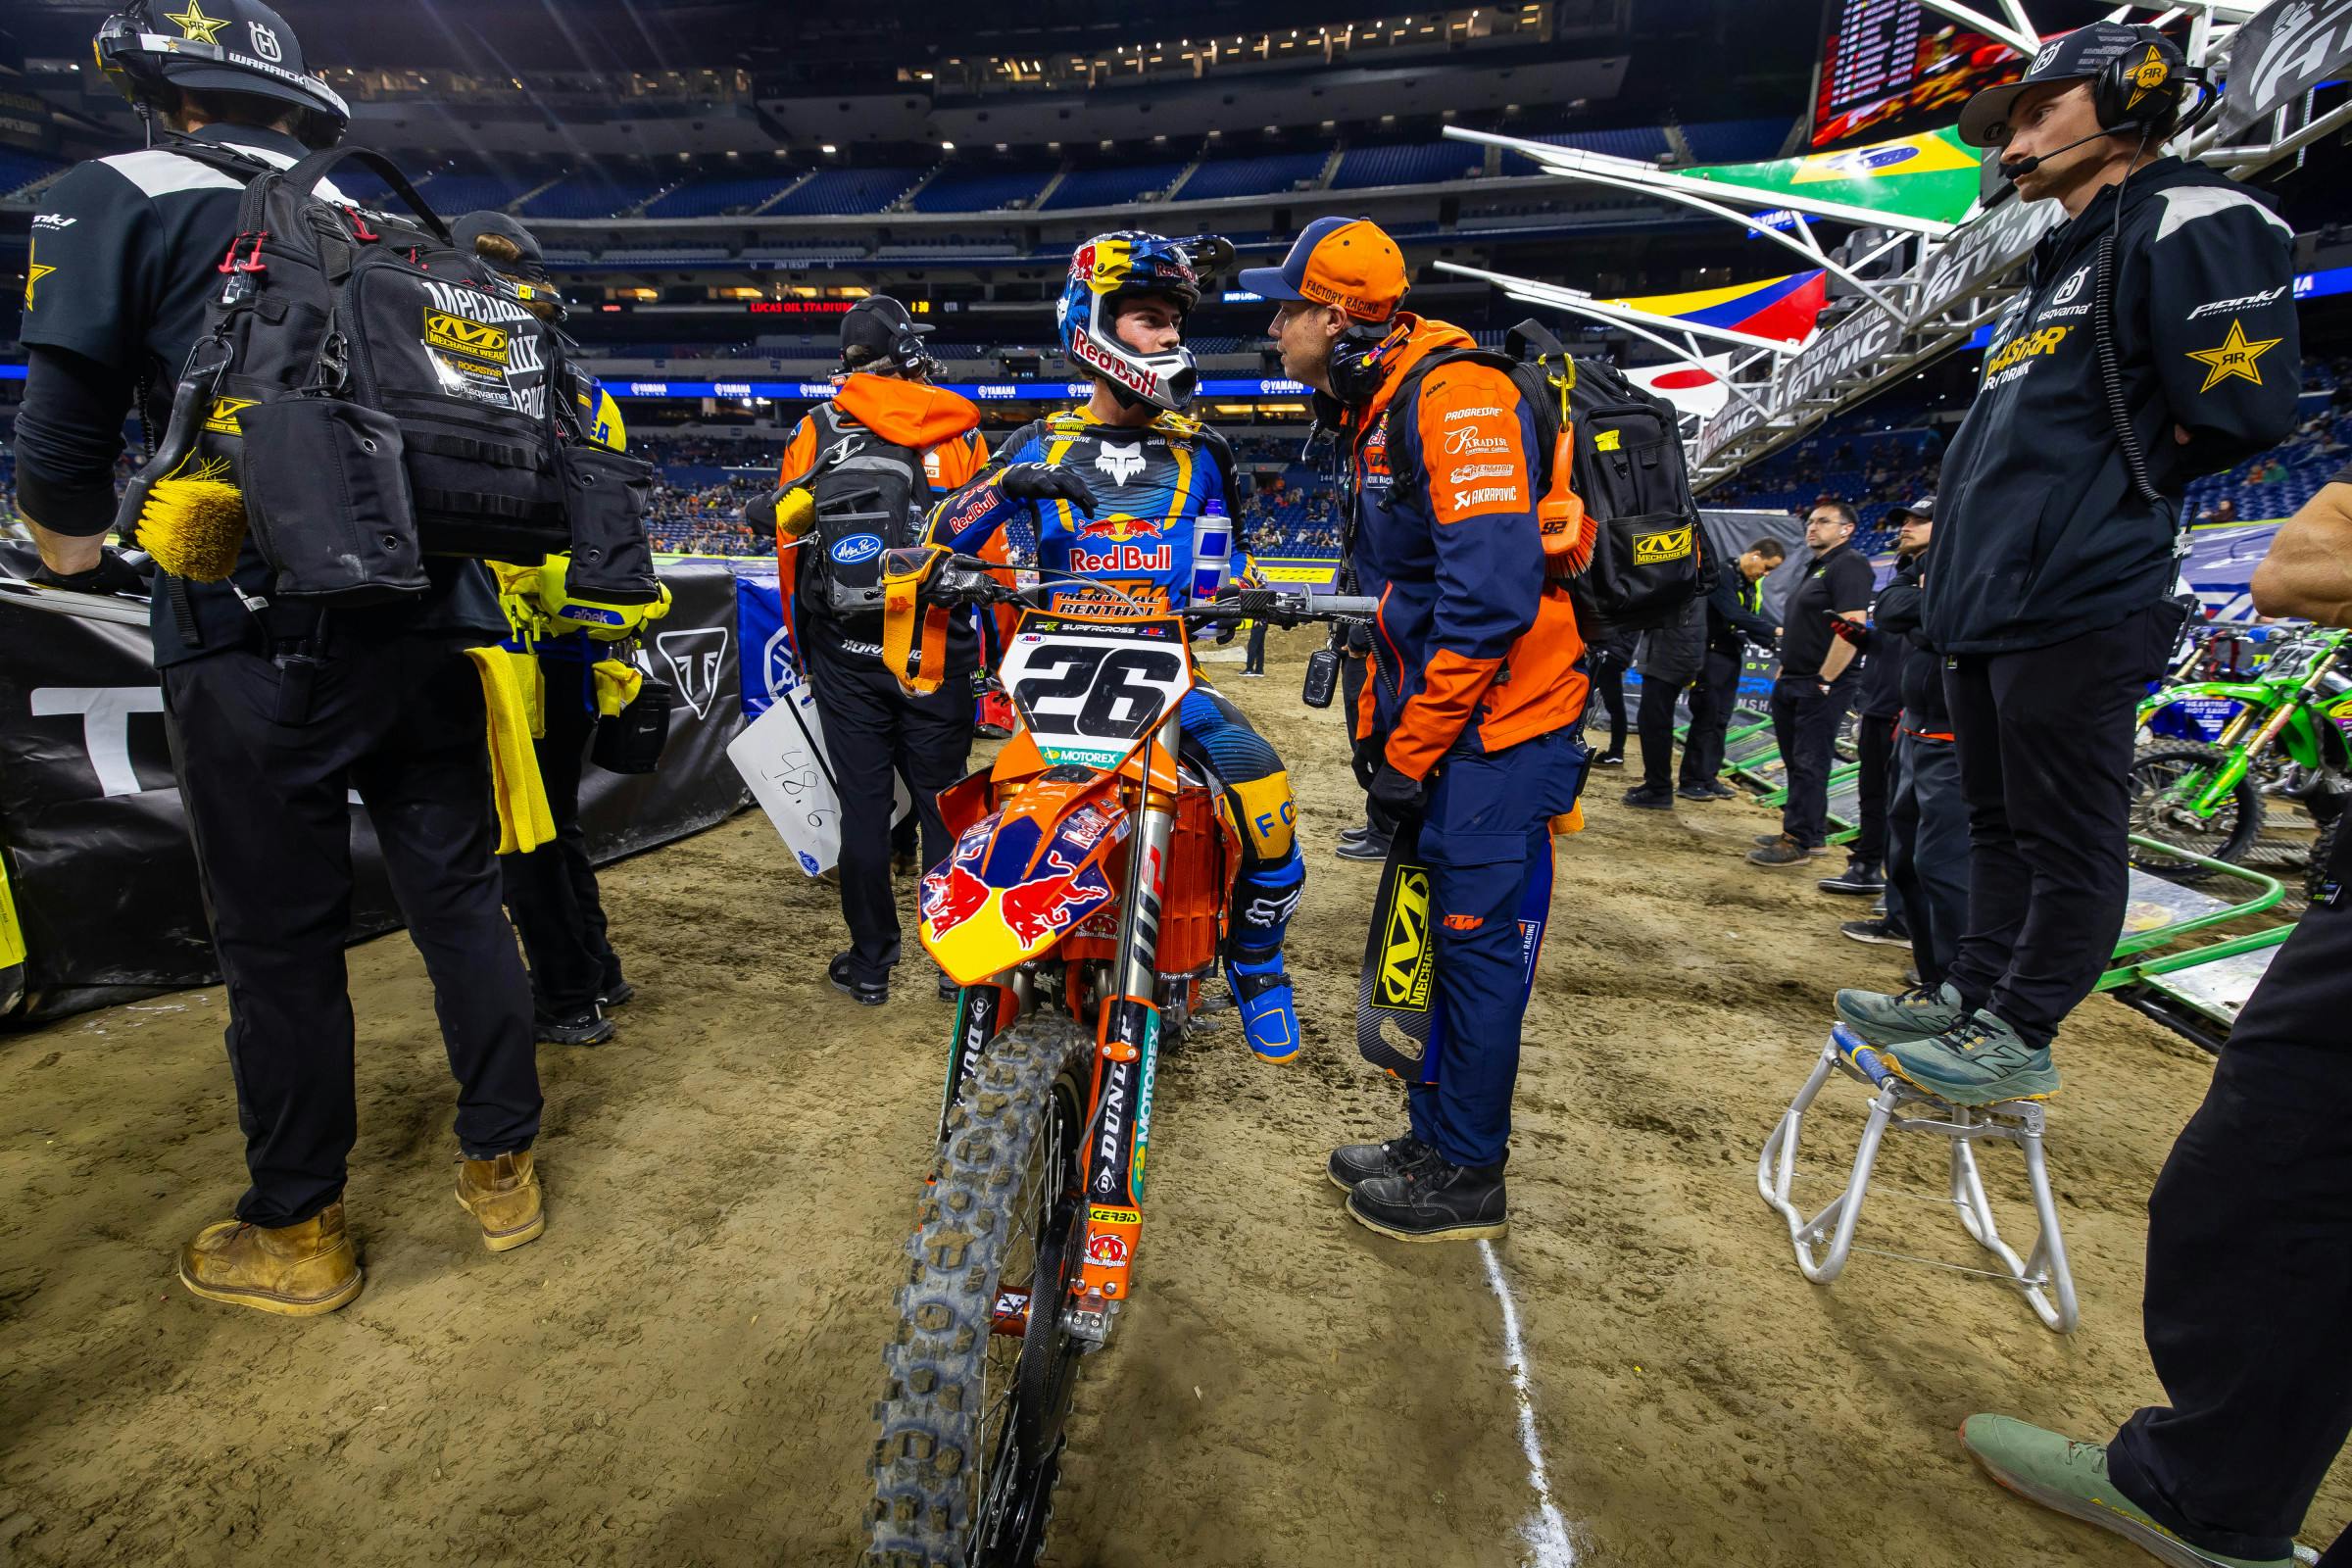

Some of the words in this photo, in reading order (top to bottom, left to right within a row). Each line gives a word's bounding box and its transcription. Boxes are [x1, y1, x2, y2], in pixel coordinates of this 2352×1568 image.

[228, 52, 306, 86] WARRICK
[32, 214, 78, 227] nkl
[1305, 280, 1344, 305] FACTORY
[1346, 296, 1380, 316] RACING
[2186, 285, 2287, 320] pankl
[751, 302, 782, 313] LUCAS
[784, 302, 802, 313] OIL
[804, 302, 855, 313] STADIUM
[429, 332, 478, 355] MECHANIX
[479, 347, 508, 362] WEAR
[457, 360, 503, 378] ROCKSTAR
[1073, 324, 1113, 369] Red
[1112, 357, 1158, 399] Bull
[721, 384, 752, 394] YAMAHA
[808, 384, 837, 394] YAMAHA
[987, 385, 1016, 395] YAMAHA
[1270, 381, 1304, 390] YAMAHA
[1444, 407, 1503, 422] PROGRESSIVE
[950, 504, 977, 535] Red
[971, 490, 1000, 518] Bull
[1541, 520, 1568, 535] 92
[1069, 545, 1120, 573] Red
[1122, 544, 1172, 571] Bull
[1637, 551, 1681, 564] MECHANIX
[1199, 585, 1217, 596] Red
[1061, 623, 1137, 634] SUPERCROSS
[1013, 644, 1182, 740] 26
[1060, 750, 1117, 764] MOTOREX
[1443, 914, 1485, 931] KTM
[1523, 924, 1536, 951] RACING
[1137, 1026, 1160, 1142] MOTOREX
